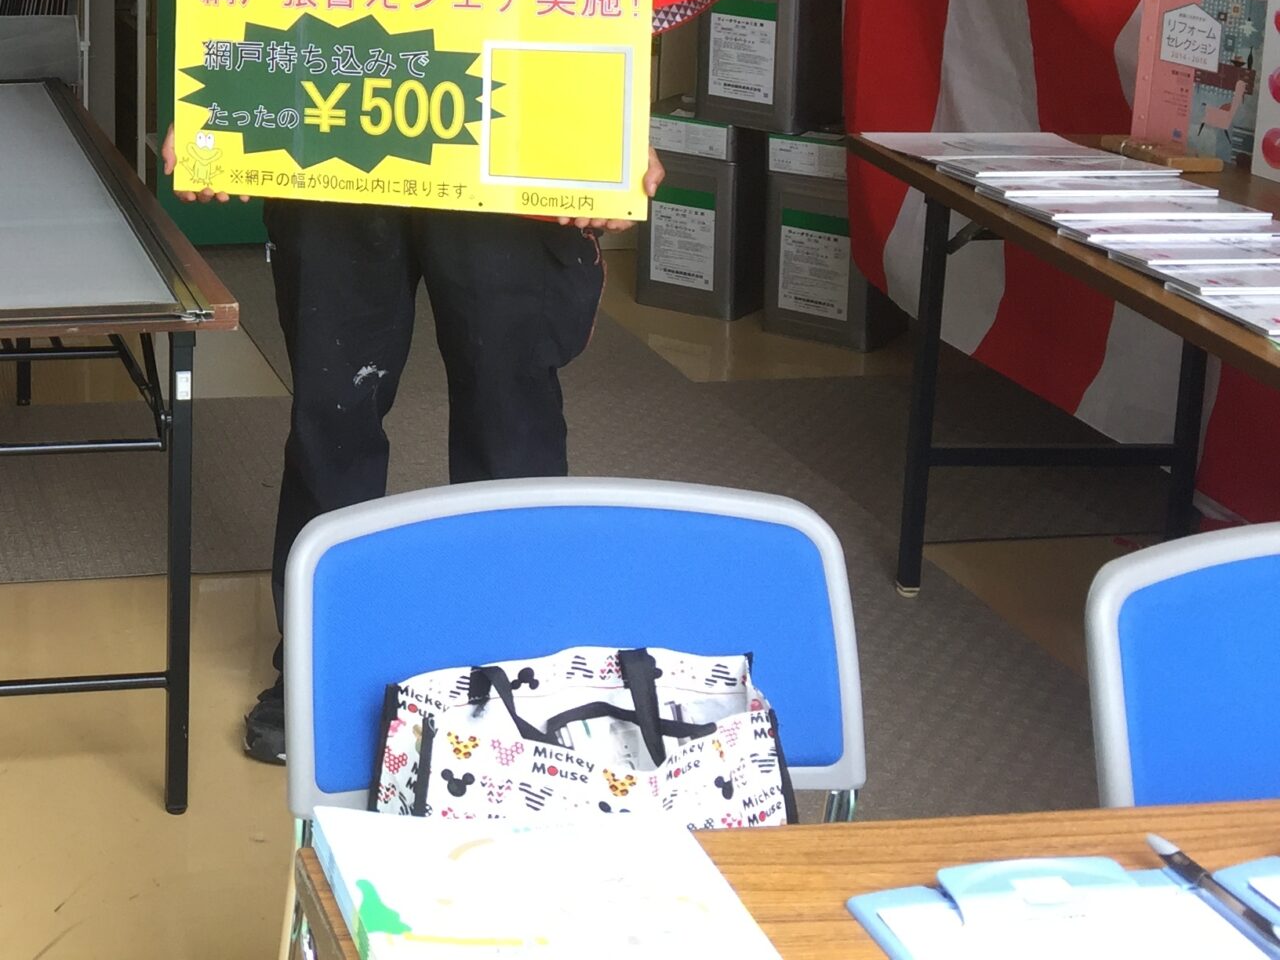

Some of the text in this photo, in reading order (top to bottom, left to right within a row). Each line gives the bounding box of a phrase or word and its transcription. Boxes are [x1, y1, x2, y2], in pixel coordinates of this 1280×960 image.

[1168, 18, 1217, 40] リフォーム
[203, 38, 430, 79] 網戸持ち込みで
[1166, 35, 1217, 56] セレクション
[207, 103, 299, 130] たったの
[521, 191, 594, 211] 90cm以内
[397, 685, 450, 713] Mickey
[531, 761, 590, 784] Mouse
[533, 745, 595, 774] Mickey
[666, 759, 701, 781] Mouse
[742, 784, 784, 810] Mickey
[747, 801, 783, 827] Mouse
